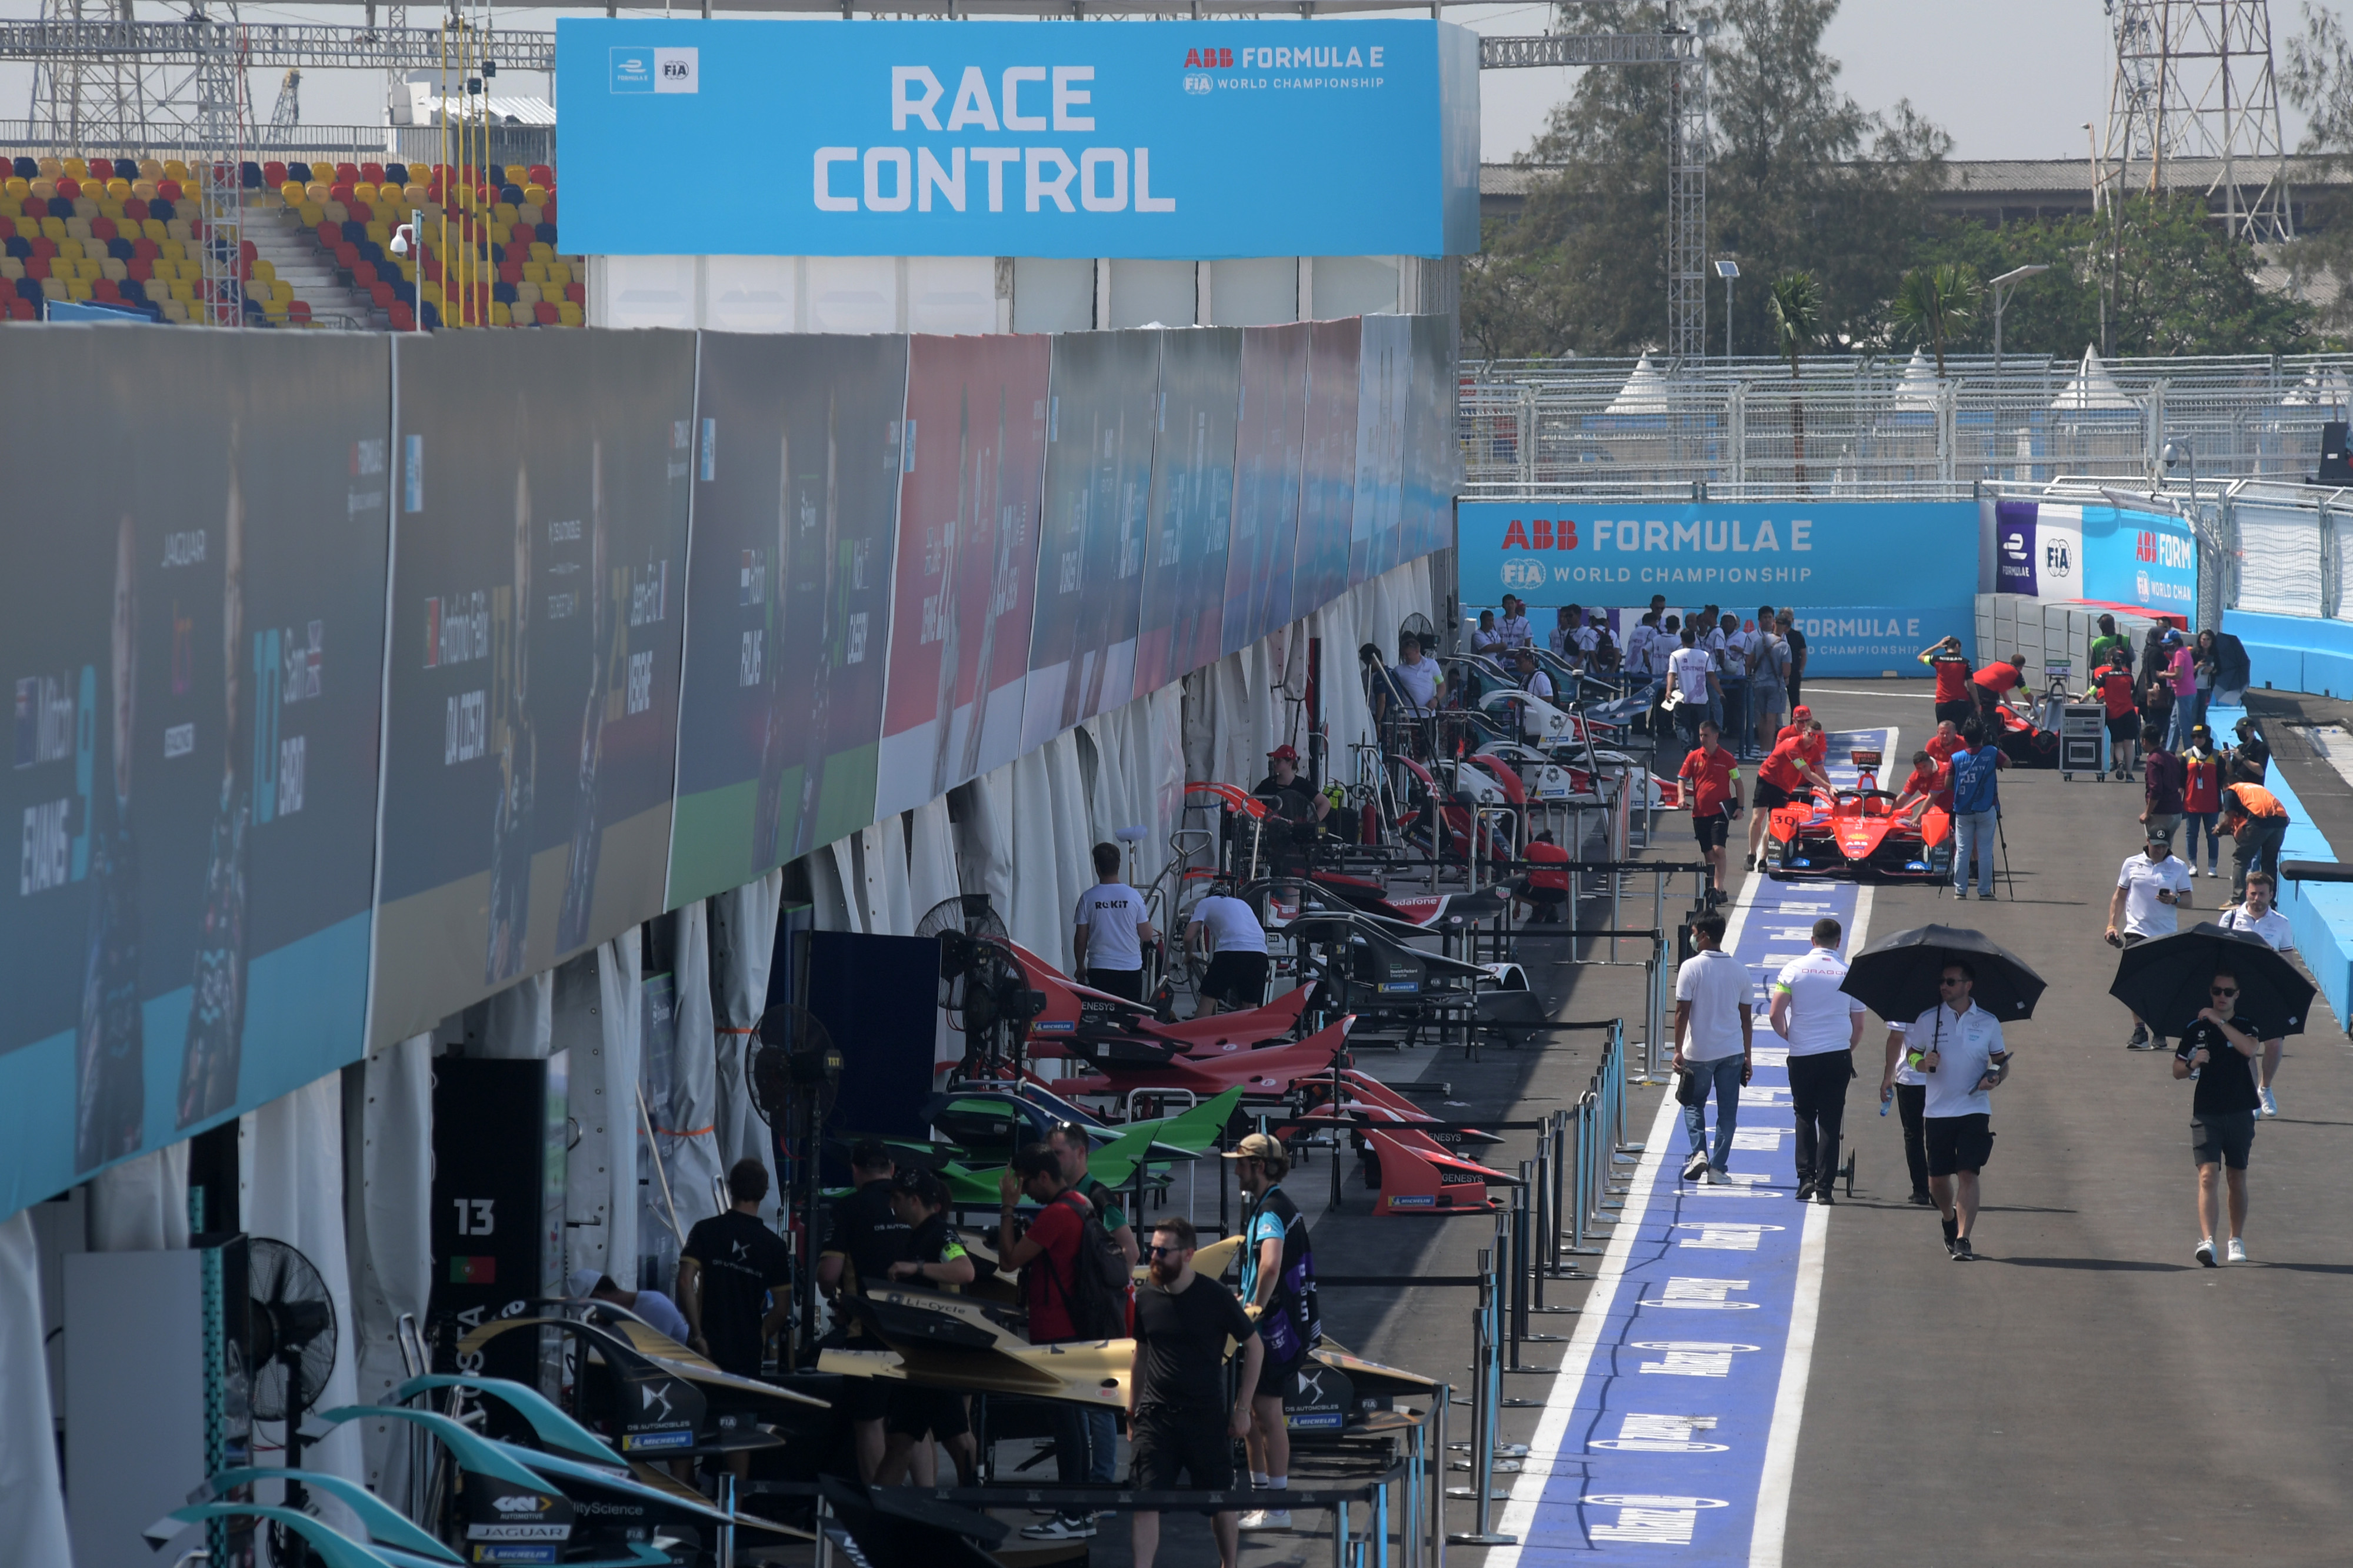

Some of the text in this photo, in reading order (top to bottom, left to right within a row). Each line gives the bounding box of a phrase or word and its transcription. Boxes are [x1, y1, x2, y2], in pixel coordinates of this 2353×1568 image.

[1184, 46, 1384, 68] ABB FORMULA E
[1218, 78, 1267, 89] WORLD
[1274, 76, 1384, 89] CHAMPIONSHIP
[892, 66, 1095, 131] RACE
[814, 147, 1175, 212] CONTROL
[1501, 519, 1812, 552] ABB FORMULA E
[161, 529, 206, 567] JAGUAR
[2136, 531, 2157, 563] ABB
[1554, 566, 1631, 583] WORLD
[1641, 566, 1812, 583] CHAMPIONSHIP
[1793, 619, 1919, 637] FORMULA E
[1821, 645, 1919, 655] CHAMPIONSHIP
[284, 627, 306, 703] Sam
[252, 628, 280, 826] 10
[279, 736, 305, 816] BIRD
[21, 798, 68, 896] EVANS
[1081, 1002, 1115, 1012] ENESYS
[1442, 1173, 1484, 1183] GENESYS
[454, 1199, 495, 1235] 13
[906, 1297, 966, 1315] Li-Cycle
[642, 1420, 691, 1430] AUTOMOBILES
[720, 1418, 736, 1426] FIA
[643, 1436, 686, 1445] MICHELIN
[477, 1527, 563, 1537] JAGUAR
[497, 1550, 548, 1560] MICHELIN
